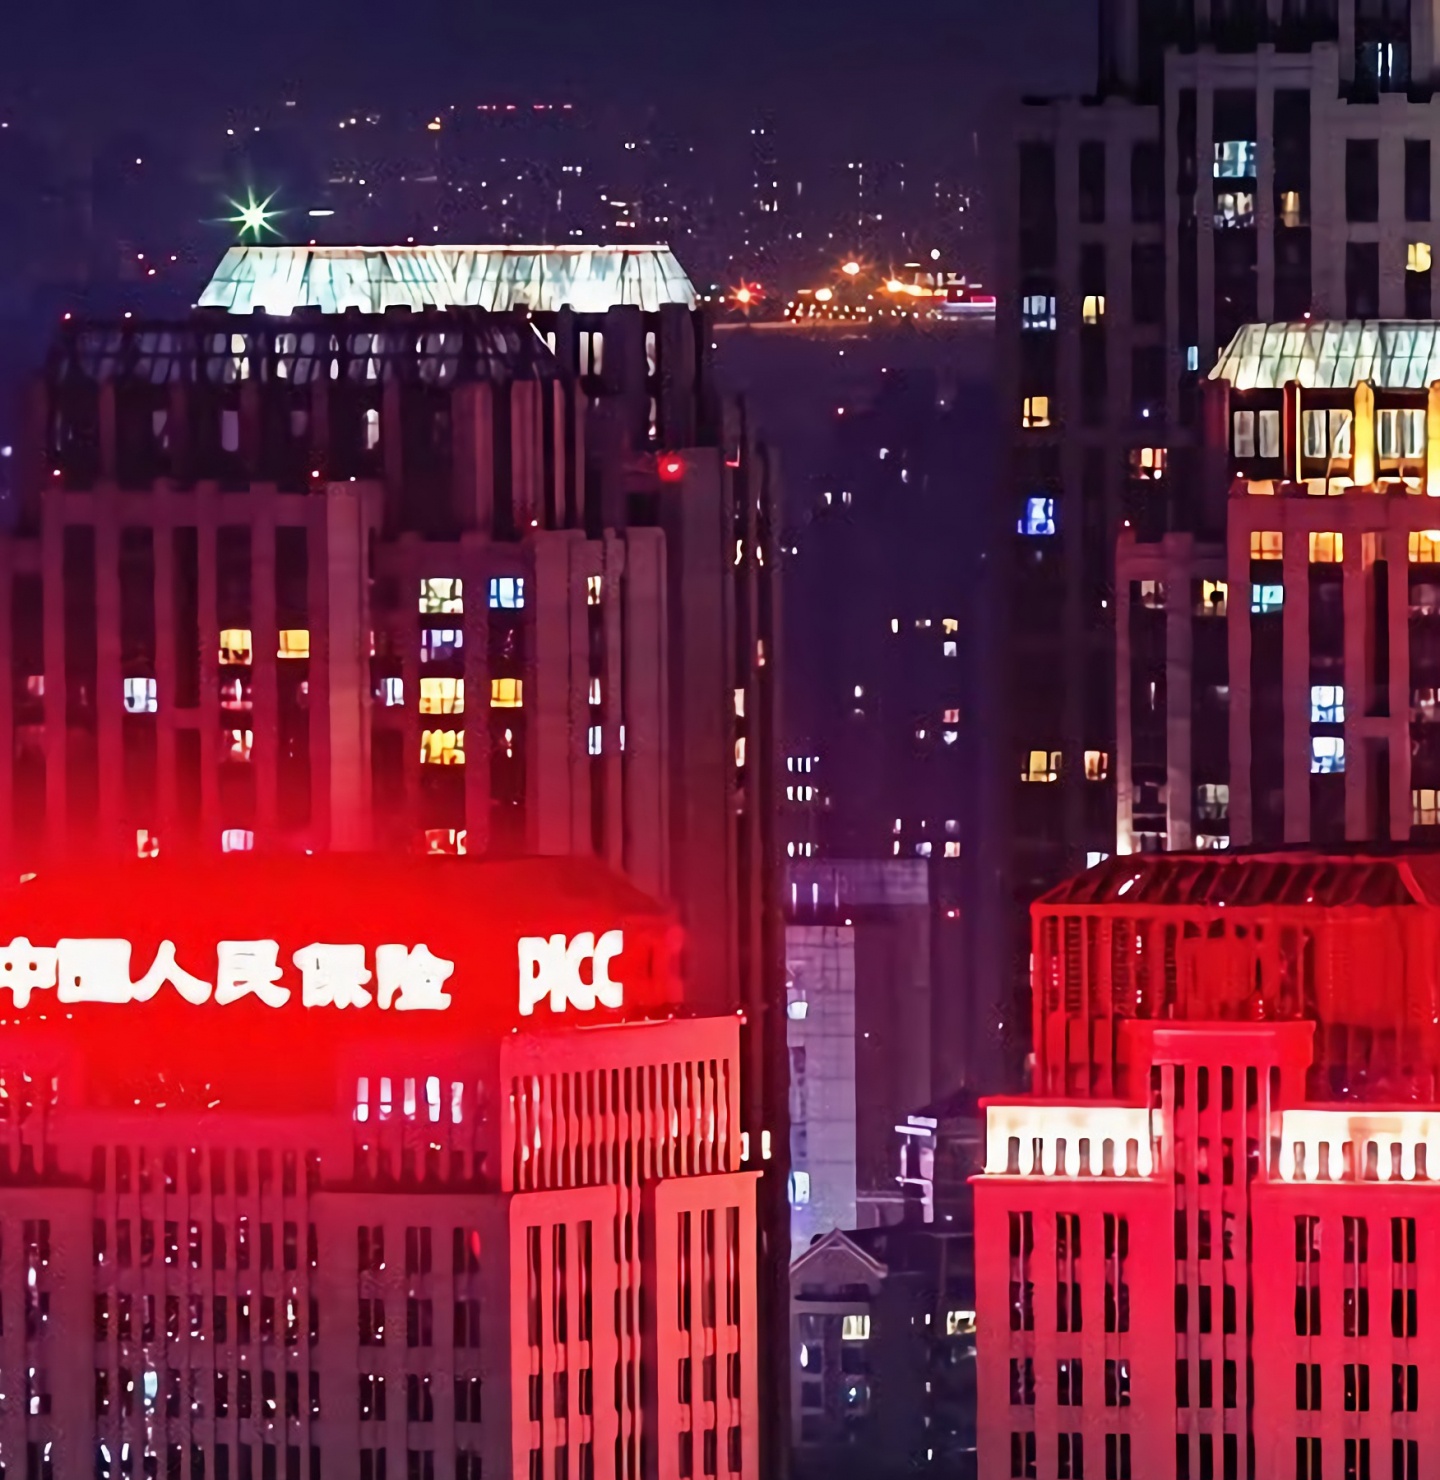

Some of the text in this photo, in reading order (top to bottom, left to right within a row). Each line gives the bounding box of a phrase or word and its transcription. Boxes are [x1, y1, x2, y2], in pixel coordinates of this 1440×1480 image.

[0, 936, 455, 1010] 中国人民保险
[517, 930, 624, 1015] PICC
